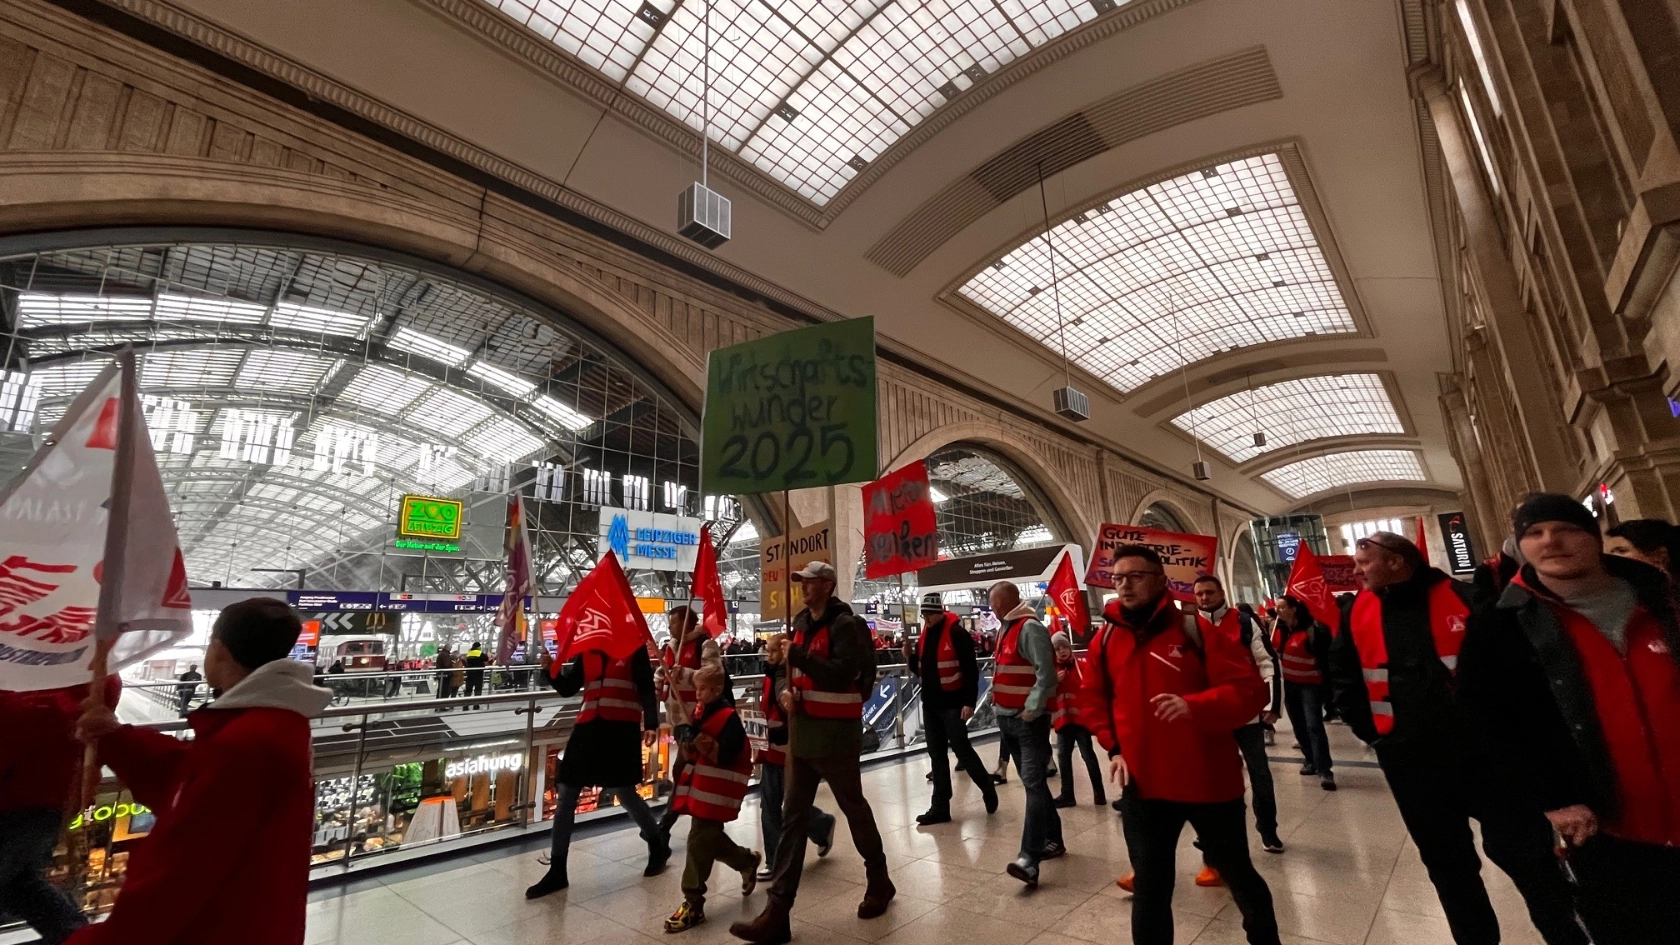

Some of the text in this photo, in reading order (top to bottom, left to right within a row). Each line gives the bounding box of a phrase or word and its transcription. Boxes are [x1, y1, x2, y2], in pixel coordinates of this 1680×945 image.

[716, 422, 855, 484] 2025
[409, 502, 457, 520] ZOO
[407, 521, 453, 534] LEIPZIG
[636, 527, 697, 545] LEIPZIGER
[1103, 526, 1147, 542] GUTE
[635, 543, 677, 559] MESSE
[1451, 532, 1471, 567] SATURN
[445, 753, 523, 778] asiahung
